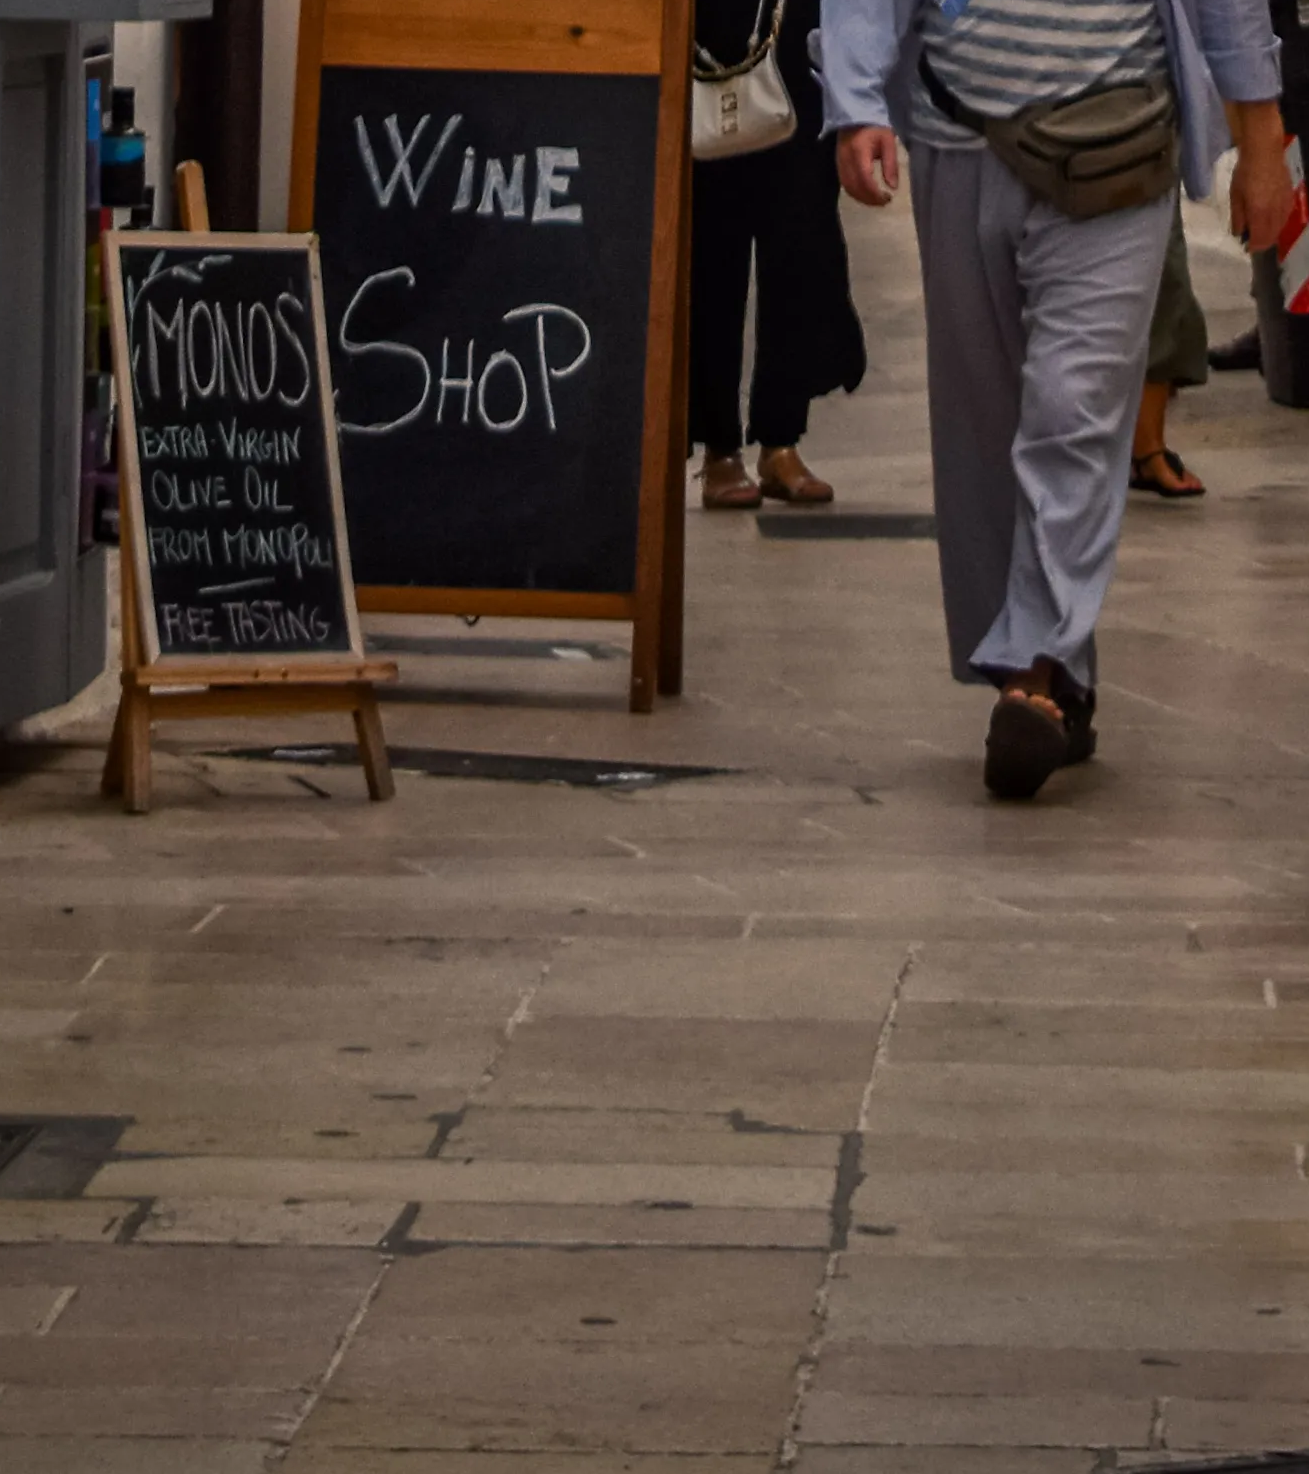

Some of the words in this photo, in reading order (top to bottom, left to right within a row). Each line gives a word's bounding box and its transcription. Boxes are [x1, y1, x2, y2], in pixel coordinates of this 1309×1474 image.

[353, 112, 584, 226] WINE
[146, 291, 312, 411] MONOS
[336, 265, 593, 434] SHOP
[151, 468, 233, 513] OLIVE
[244, 464, 295, 513] OIL
[148, 524, 214, 568] FROM
[222, 522, 335, 580] MONOPOLI
[160, 602, 223, 647] FREE
[221, 598, 332, 646] TASTING
